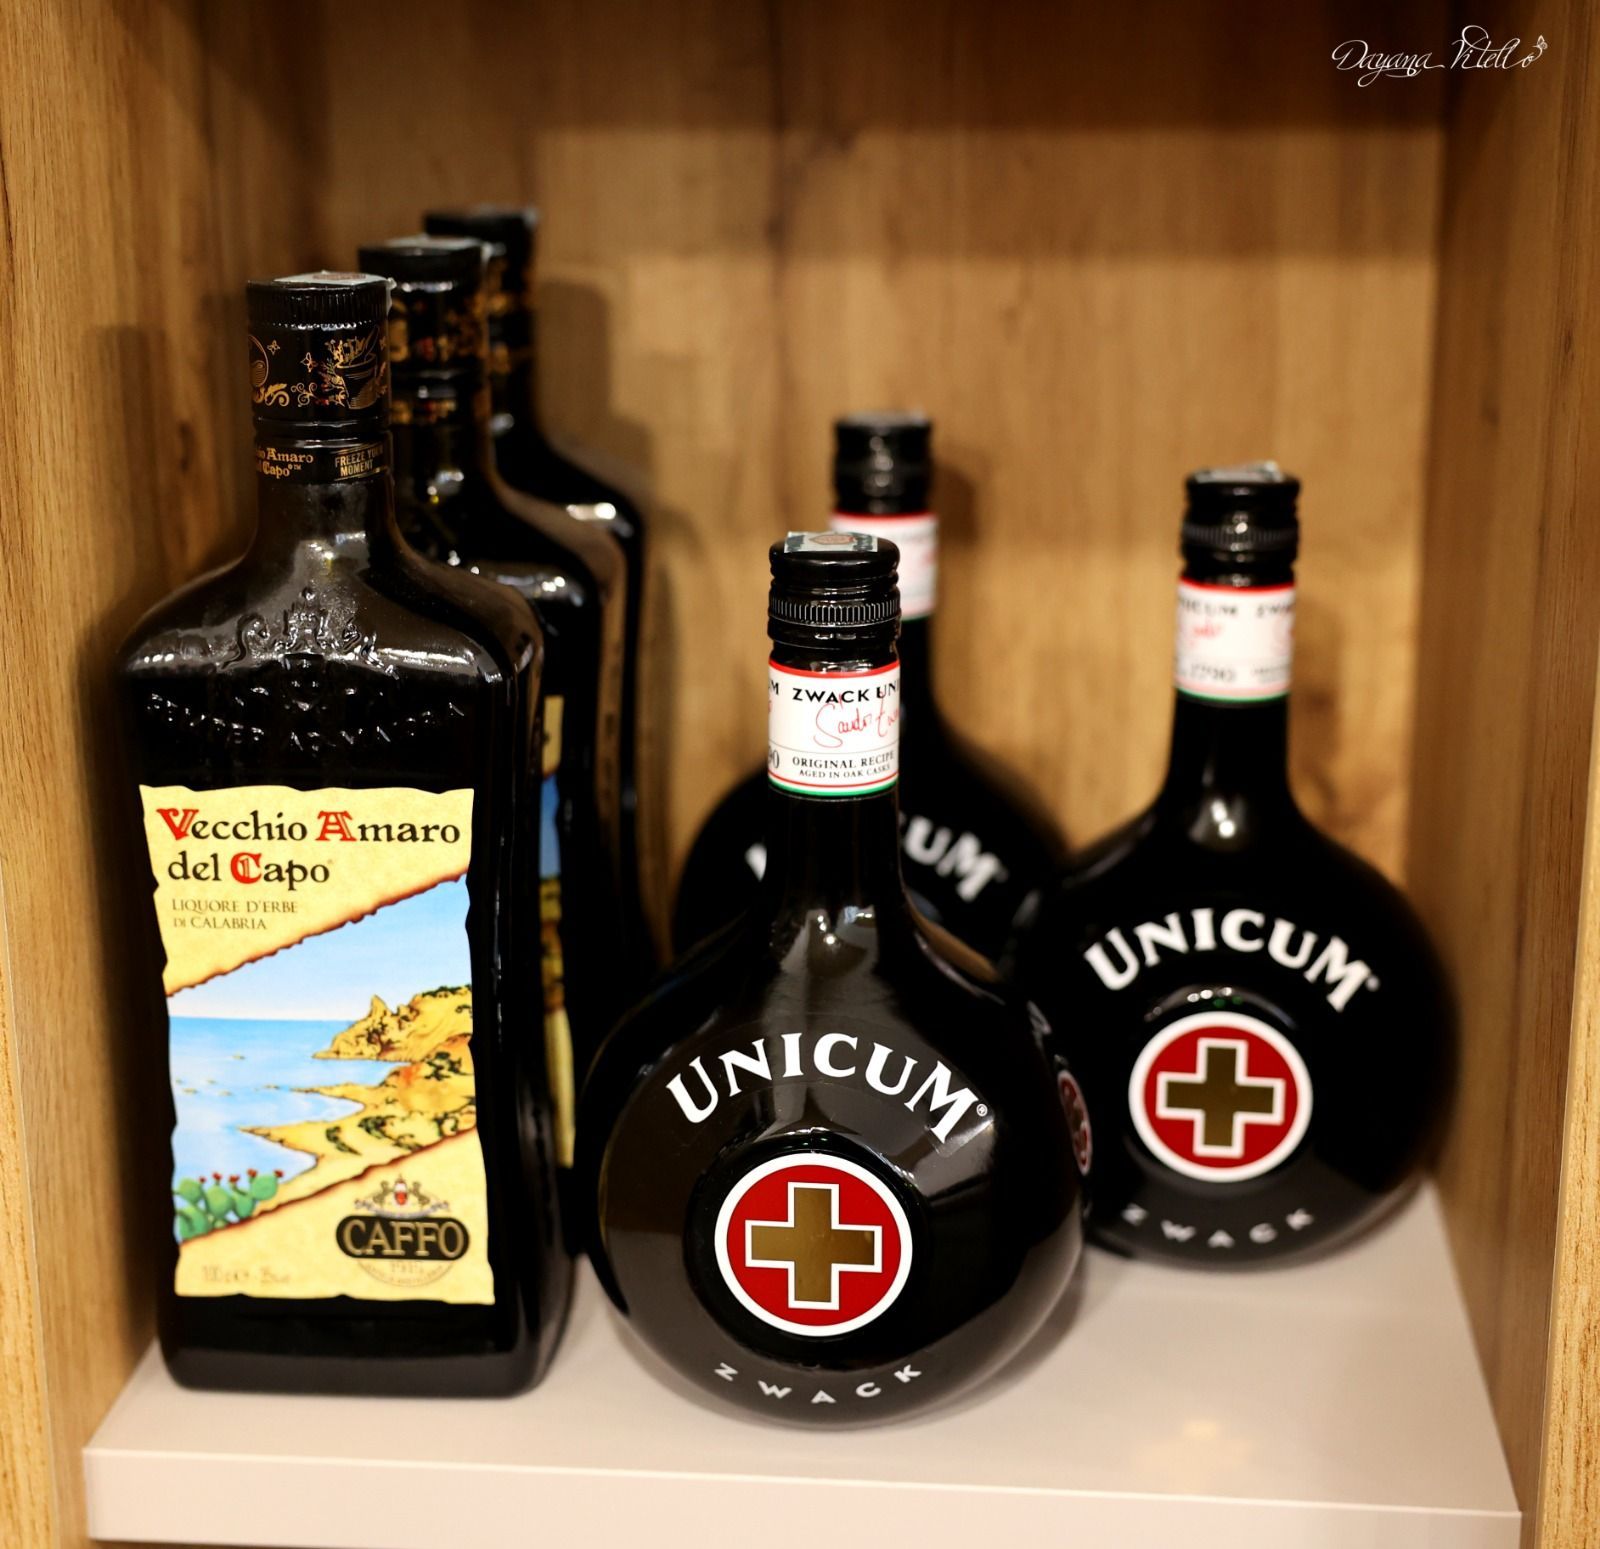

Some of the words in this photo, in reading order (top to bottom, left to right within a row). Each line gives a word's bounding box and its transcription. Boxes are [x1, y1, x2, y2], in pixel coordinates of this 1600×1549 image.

[267, 447, 314, 464] Amaro
[335, 450, 366, 468] FREEZE
[340, 458, 374, 477] MOMENT
[792, 687, 870, 704] ZWACK
[792, 755, 857, 770] ORIGINAL
[860, 750, 895, 768] RECIPE
[799, 768, 826, 779] AGED
[829, 769, 841, 779] IN
[843, 769, 864, 779] OAK
[156, 808, 308, 842] Vecchio
[315, 809, 461, 844] Amaro
[168, 850, 222, 882] del
[899, 813, 1001, 902] UM
[171, 898, 241, 914] LIQUORE
[246, 900, 299, 914] D'ERBE
[173, 917, 187, 928] DI
[190, 916, 267, 930] CALABRIA
[1083, 907, 1375, 1013] UNICUM
[342, 1218, 465, 1259] CAFFO
[713, 1361, 923, 1405] ZWACK
